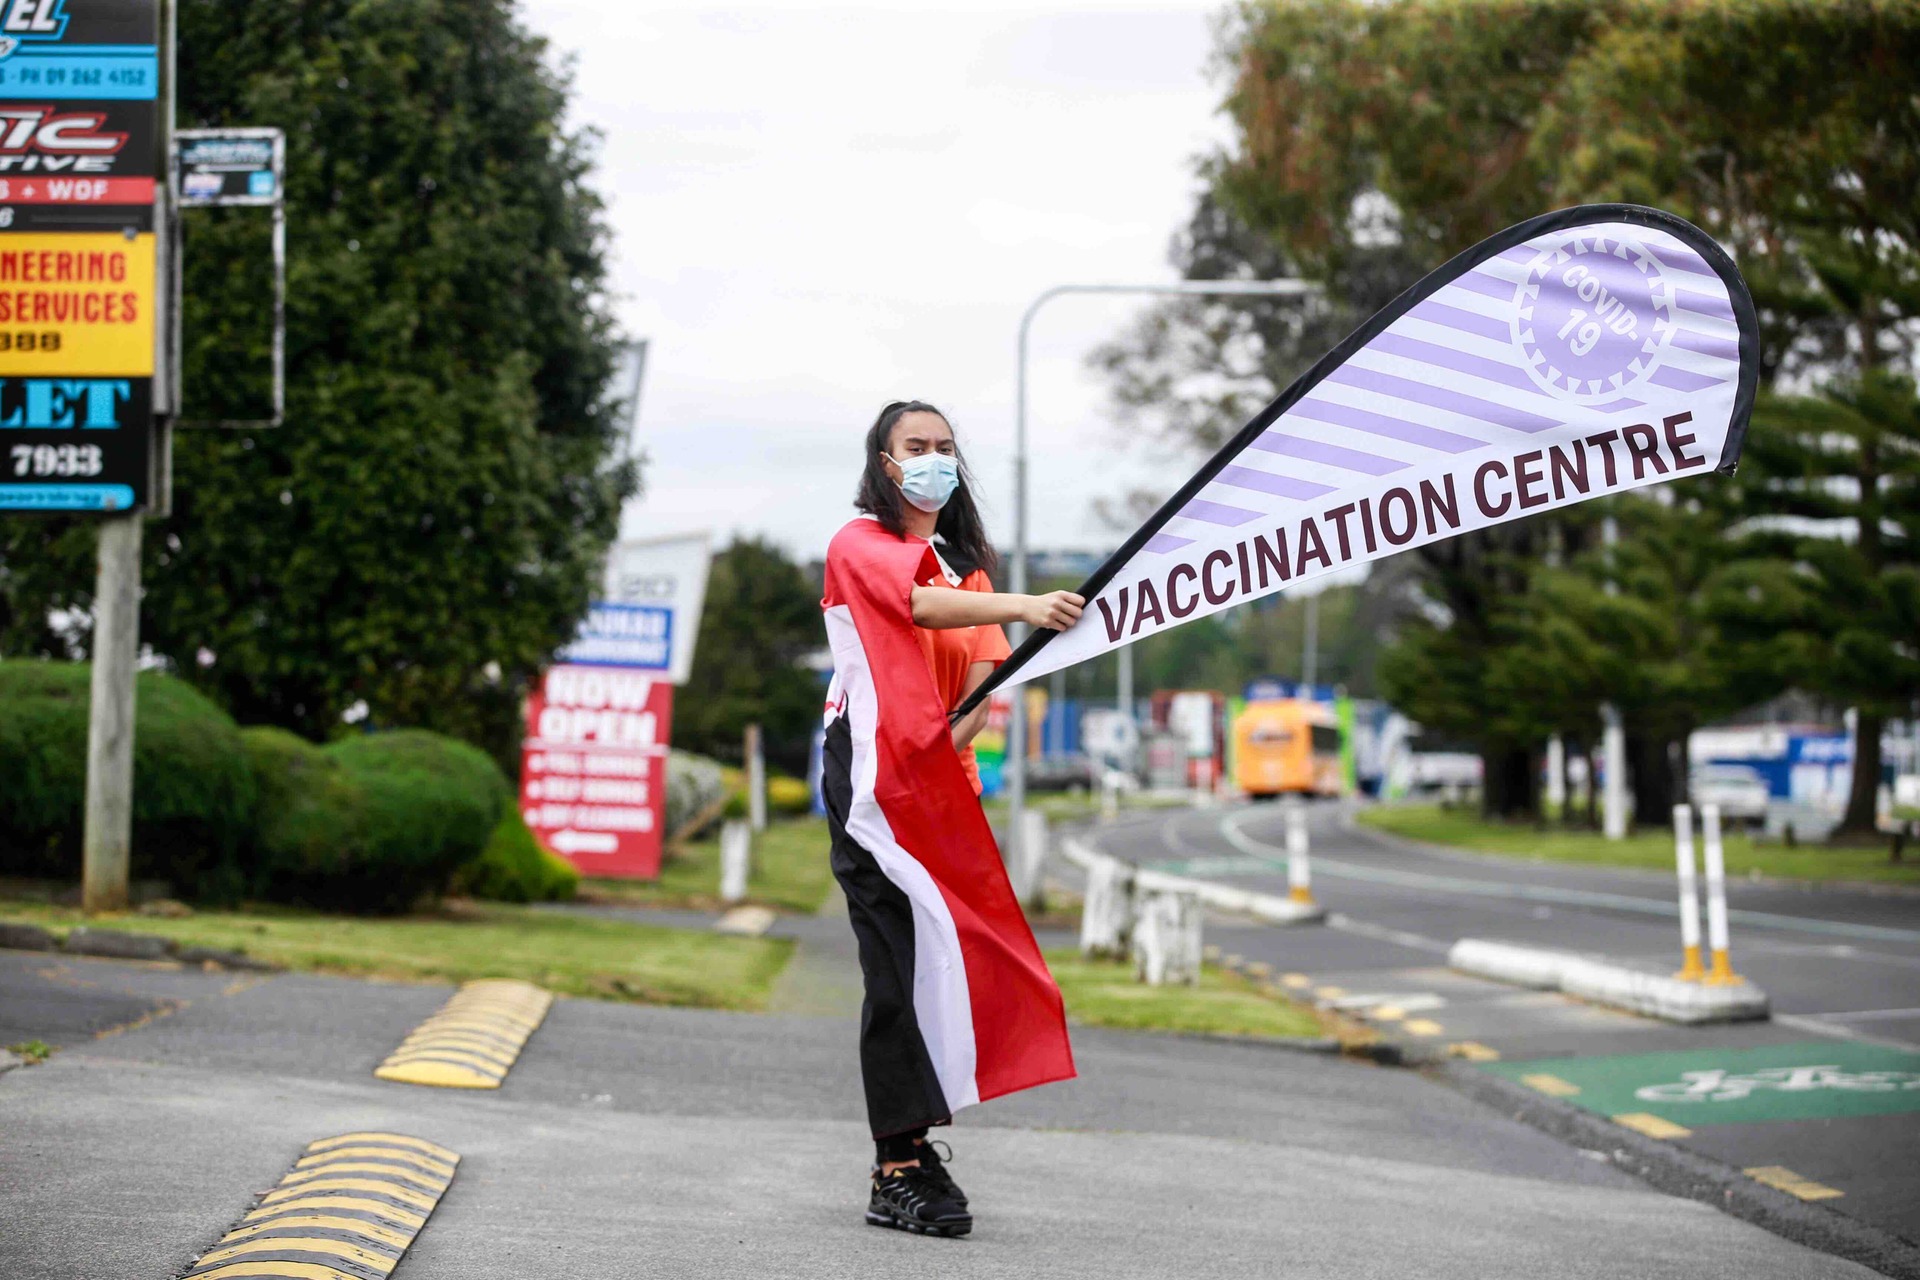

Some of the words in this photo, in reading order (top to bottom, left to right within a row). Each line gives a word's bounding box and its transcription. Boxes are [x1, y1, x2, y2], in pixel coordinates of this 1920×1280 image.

[0, 0, 56, 31] EL
[47, 179, 109, 200] WOF
[1, 251, 126, 282] NEERING
[0, 292, 138, 323] SERVICES
[1556, 308, 1602, 357] 19
[10, 443, 103, 477] 7933
[1473, 410, 1706, 518] CENTRE
[1095, 472, 1462, 644] VACCINATION
[545, 667, 651, 711] NOW
[538, 706, 657, 748] OPEN
